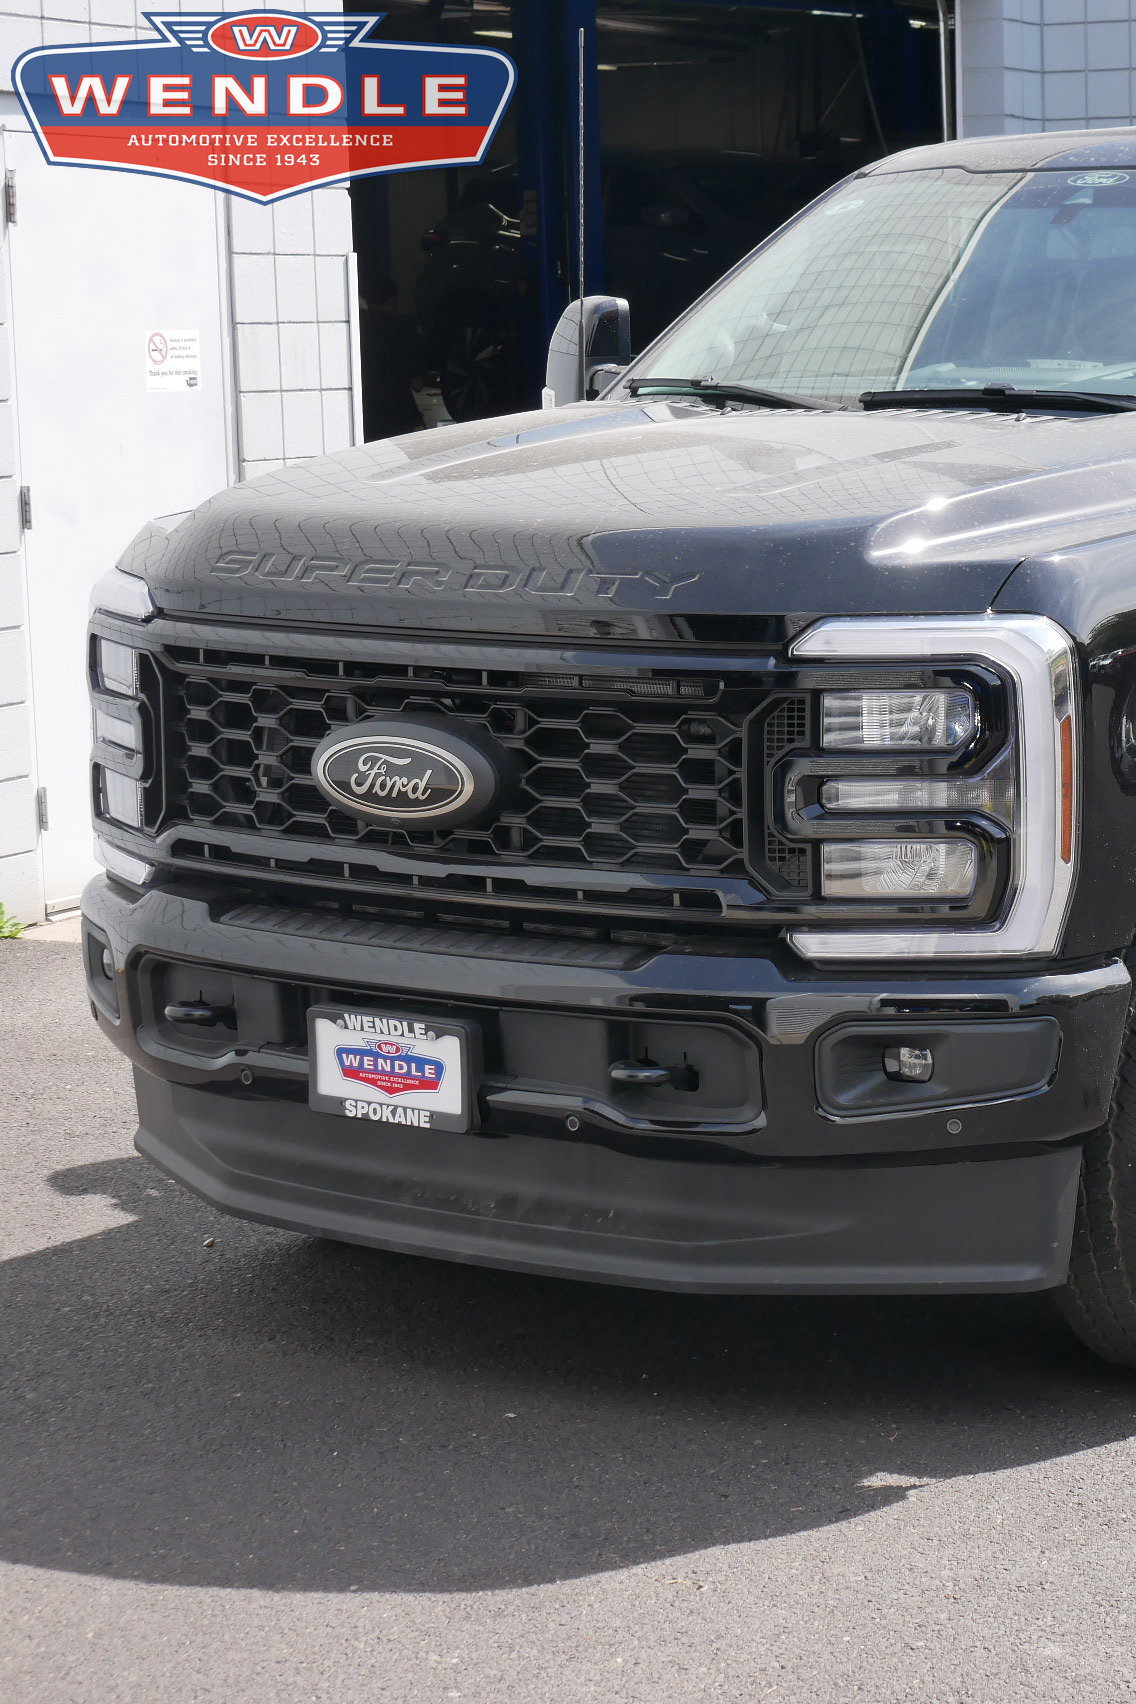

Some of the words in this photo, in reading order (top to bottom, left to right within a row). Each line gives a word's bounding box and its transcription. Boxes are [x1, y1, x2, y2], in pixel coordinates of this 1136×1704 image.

[210, 550, 453, 590] SUPER
[463, 563, 702, 599] DUTY
[351, 752, 433, 801] Ford
[343, 1013, 427, 1040] WENDLE
[342, 1053, 436, 1078] WENDLE
[344, 1099, 431, 1128] SPOKANE
